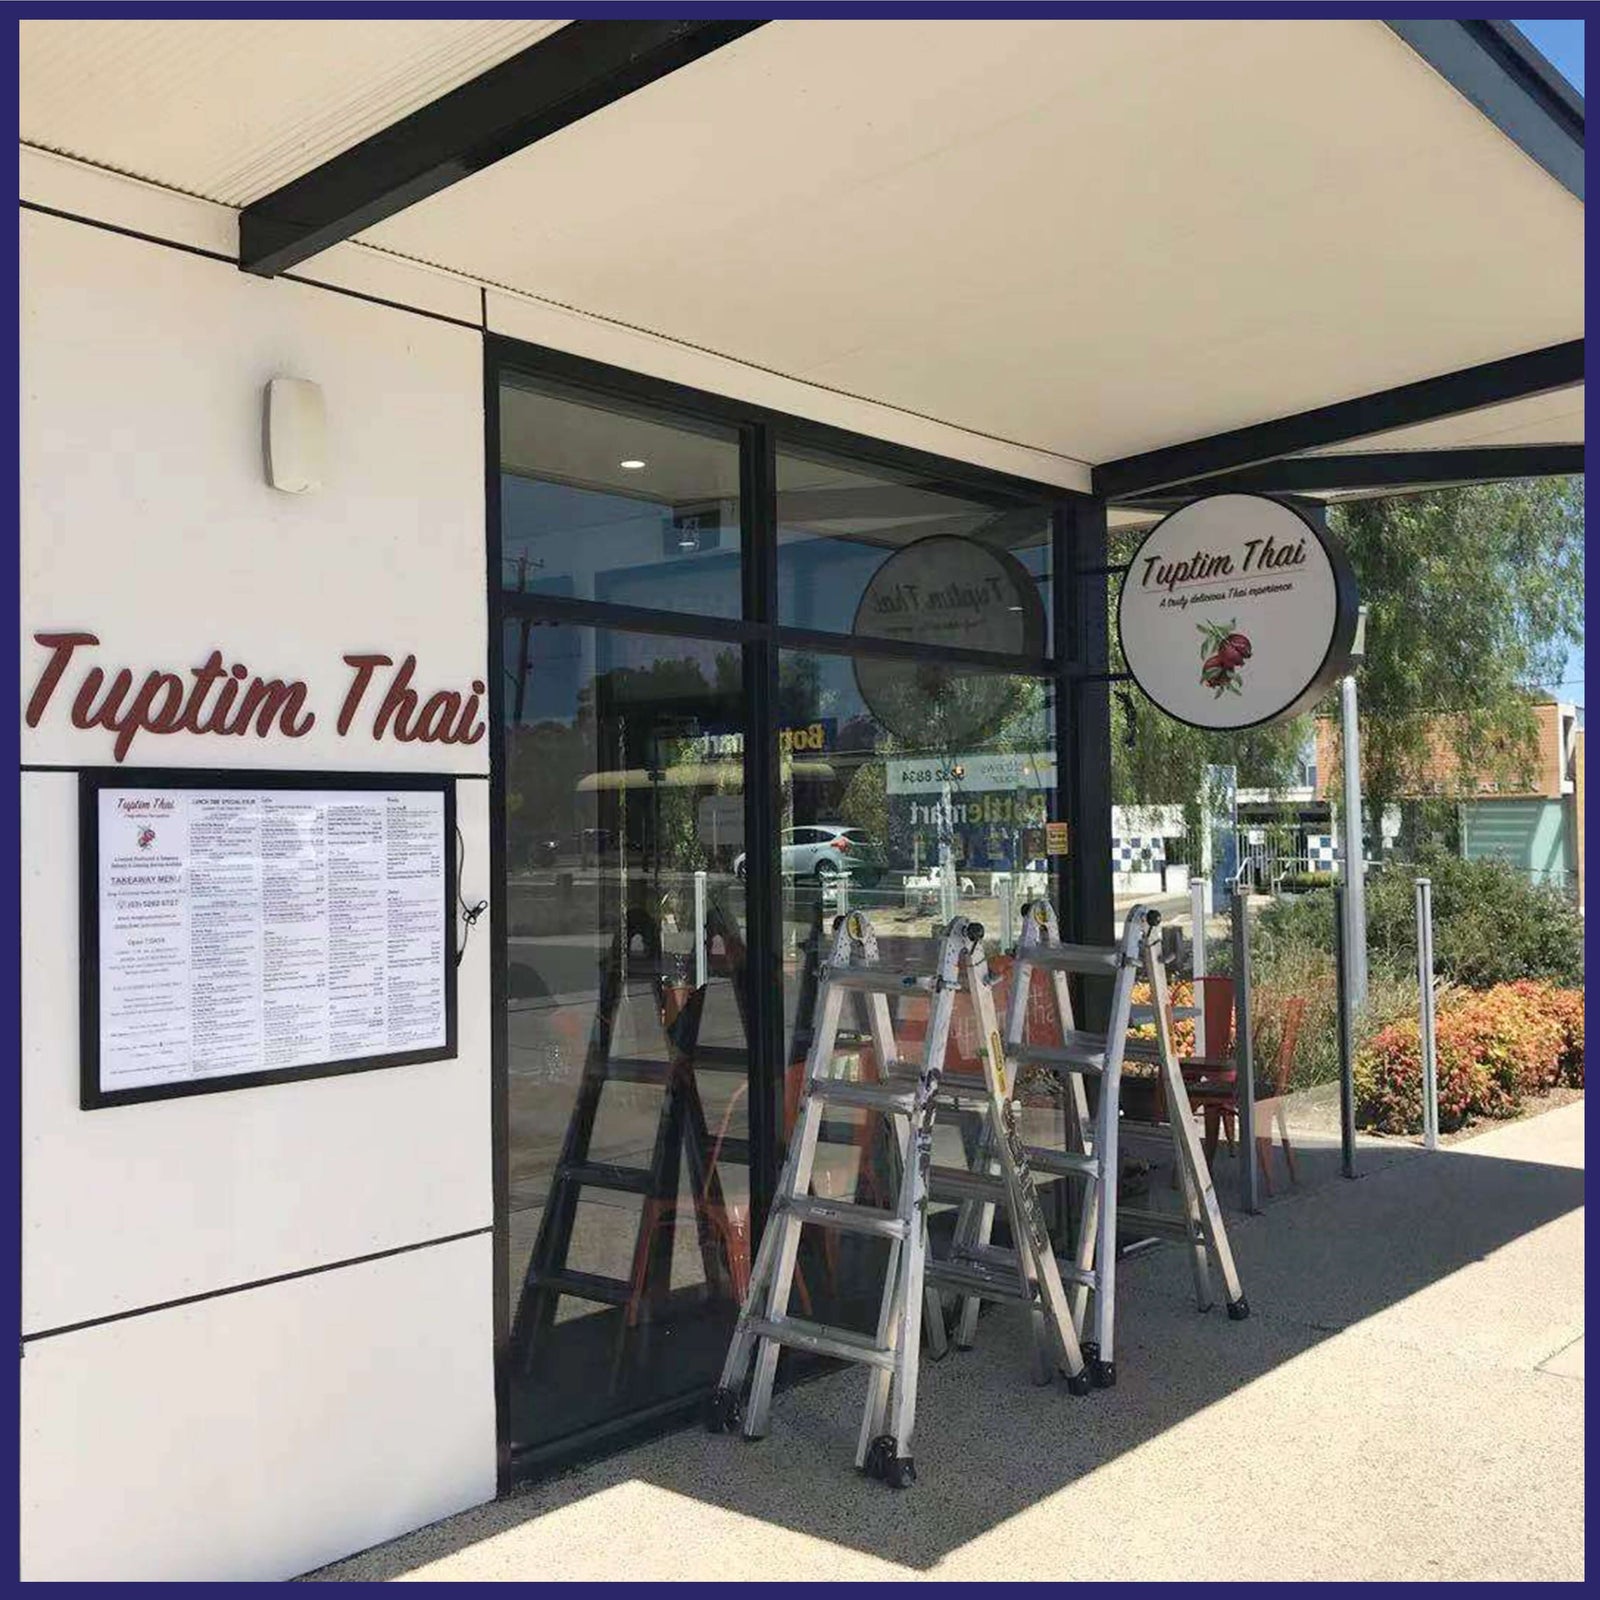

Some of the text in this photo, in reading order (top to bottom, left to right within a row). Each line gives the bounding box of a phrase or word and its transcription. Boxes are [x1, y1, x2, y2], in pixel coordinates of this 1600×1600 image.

[1142, 535, 1307, 592] Tuptim Thai
[1167, 595, 1188, 609] truly
[1190, 592, 1226, 604] delicious
[1228, 587, 1248, 599] Thai
[1248, 583, 1293, 597] experience
[25, 632, 486, 763] Tuptim Thai
[117, 797, 150, 812] Tuptim
[111, 874, 182, 886] TAKEAWAY MENU
